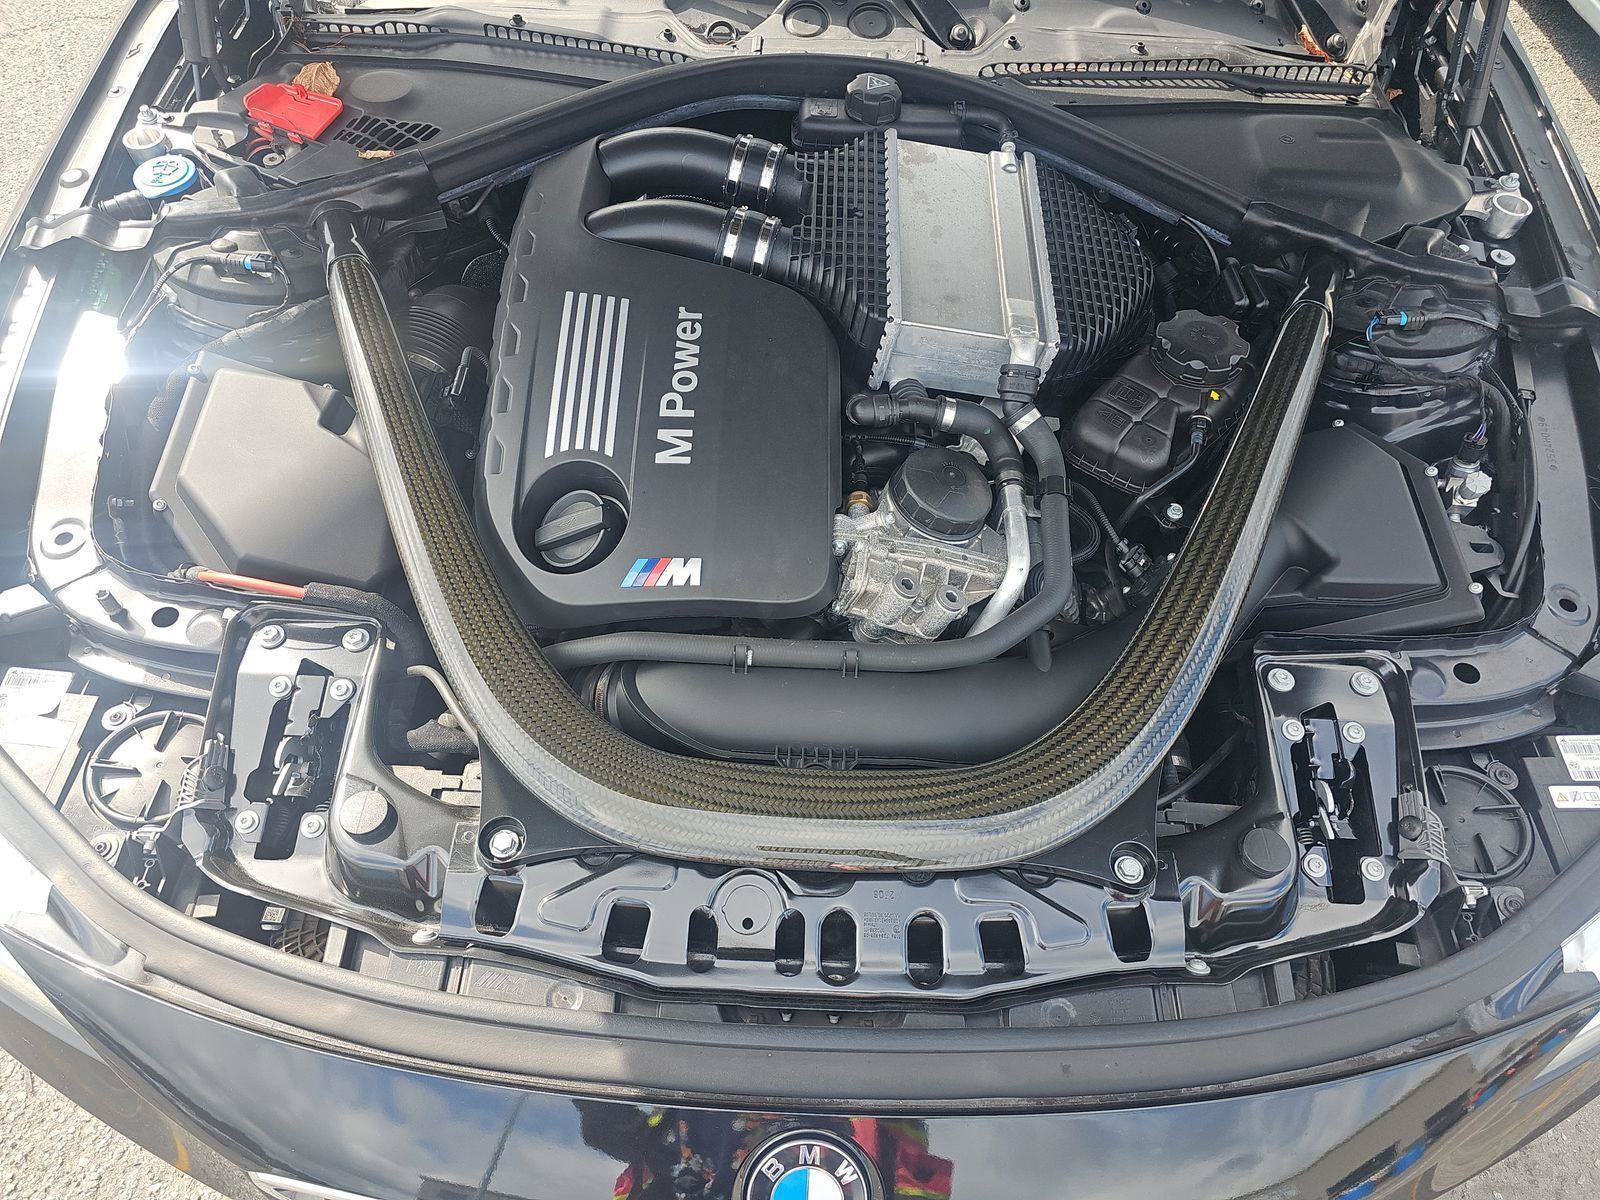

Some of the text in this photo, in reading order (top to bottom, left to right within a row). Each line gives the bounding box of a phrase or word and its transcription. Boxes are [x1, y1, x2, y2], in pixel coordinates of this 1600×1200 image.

[655, 306, 703, 464] M Power
[761, 1144, 858, 1185] BMW
